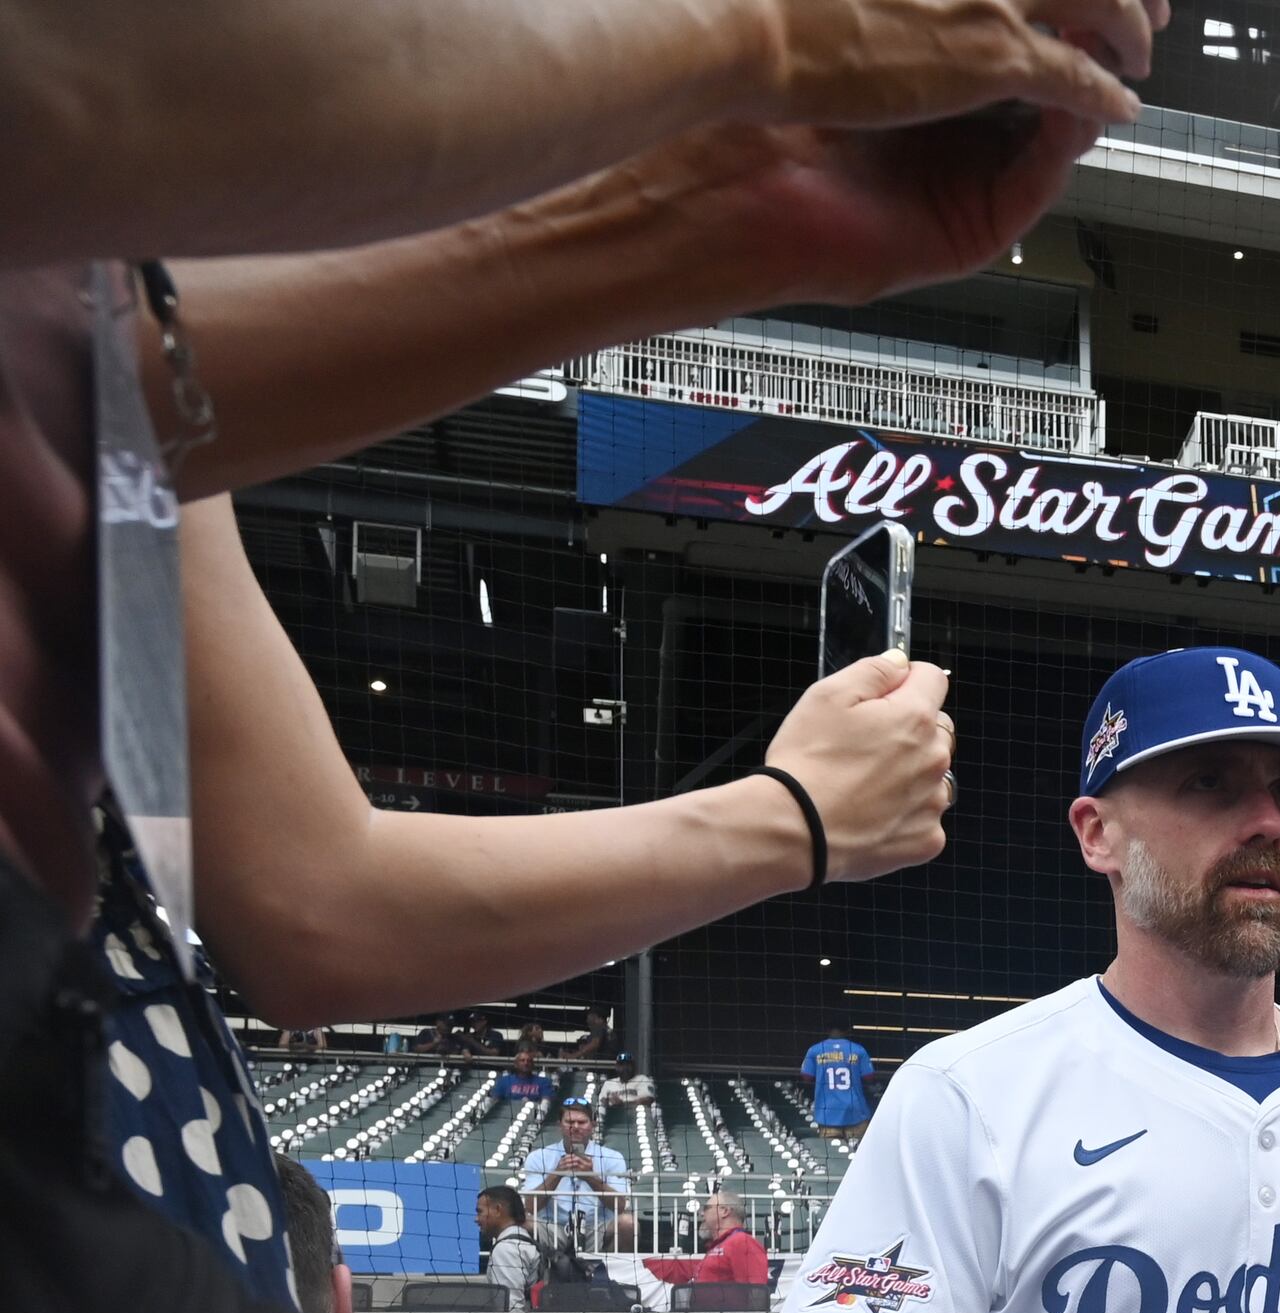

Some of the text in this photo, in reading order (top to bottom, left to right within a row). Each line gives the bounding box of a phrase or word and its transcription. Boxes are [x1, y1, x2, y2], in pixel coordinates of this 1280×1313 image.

[744, 439, 932, 523] All
[934, 453, 1127, 542] Star
[1216, 656, 1278, 723] LA
[397, 768, 506, 793] LEVEL
[826, 1067, 851, 1090] 13
[807, 1263, 845, 1285] All
[843, 1267, 881, 1289] Star
[880, 1273, 931, 1298] Game
